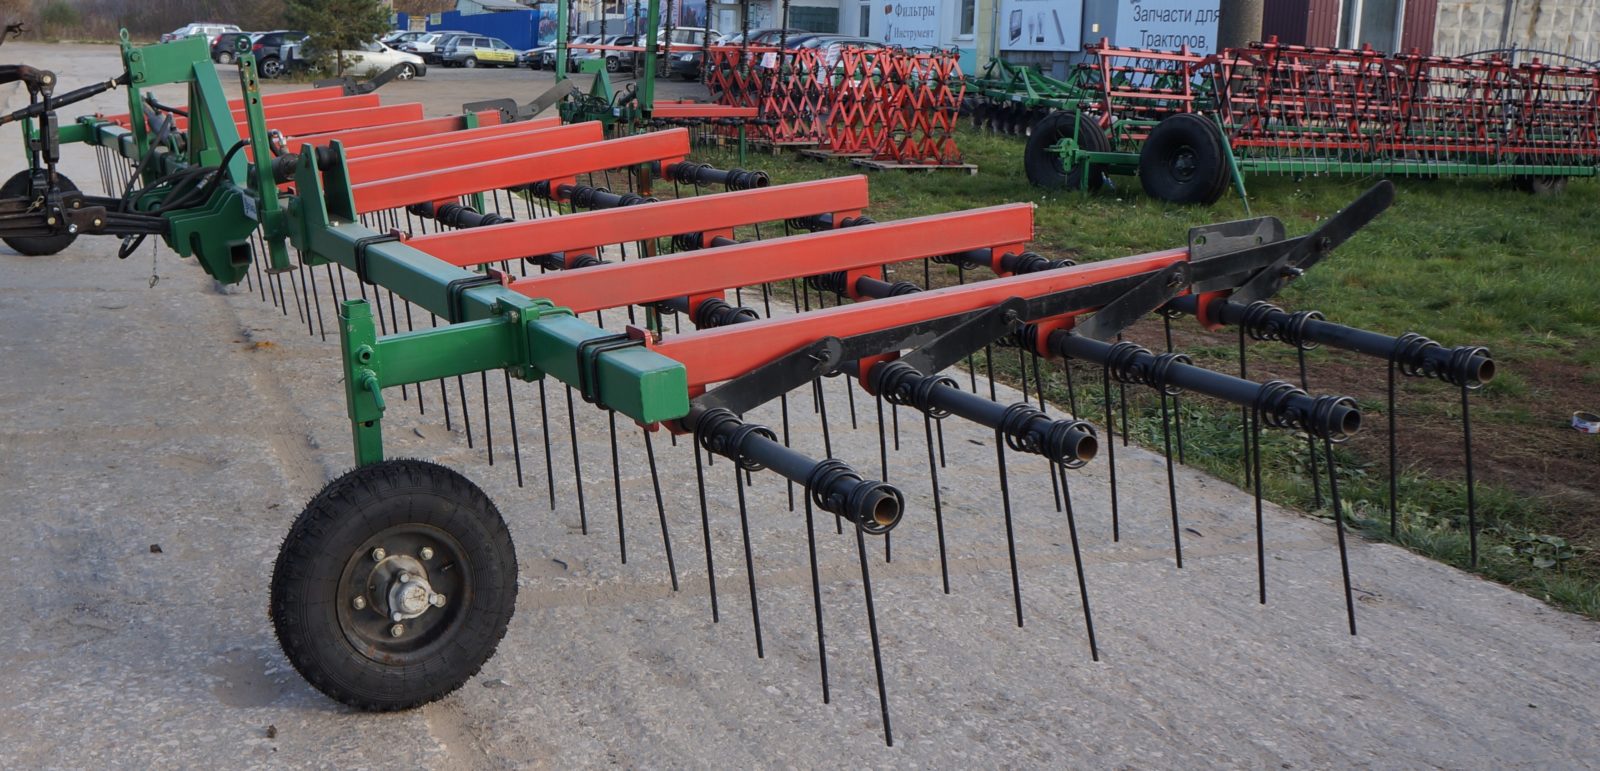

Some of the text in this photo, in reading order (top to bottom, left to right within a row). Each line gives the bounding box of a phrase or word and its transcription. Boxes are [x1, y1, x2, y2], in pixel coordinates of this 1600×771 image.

[895, 3, 935, 21] Фильтры
[1133, 5, 1221, 26] Запчасти для
[894, 27, 934, 41] Инструмент
[1140, 30, 1208, 51] Тракторов,
